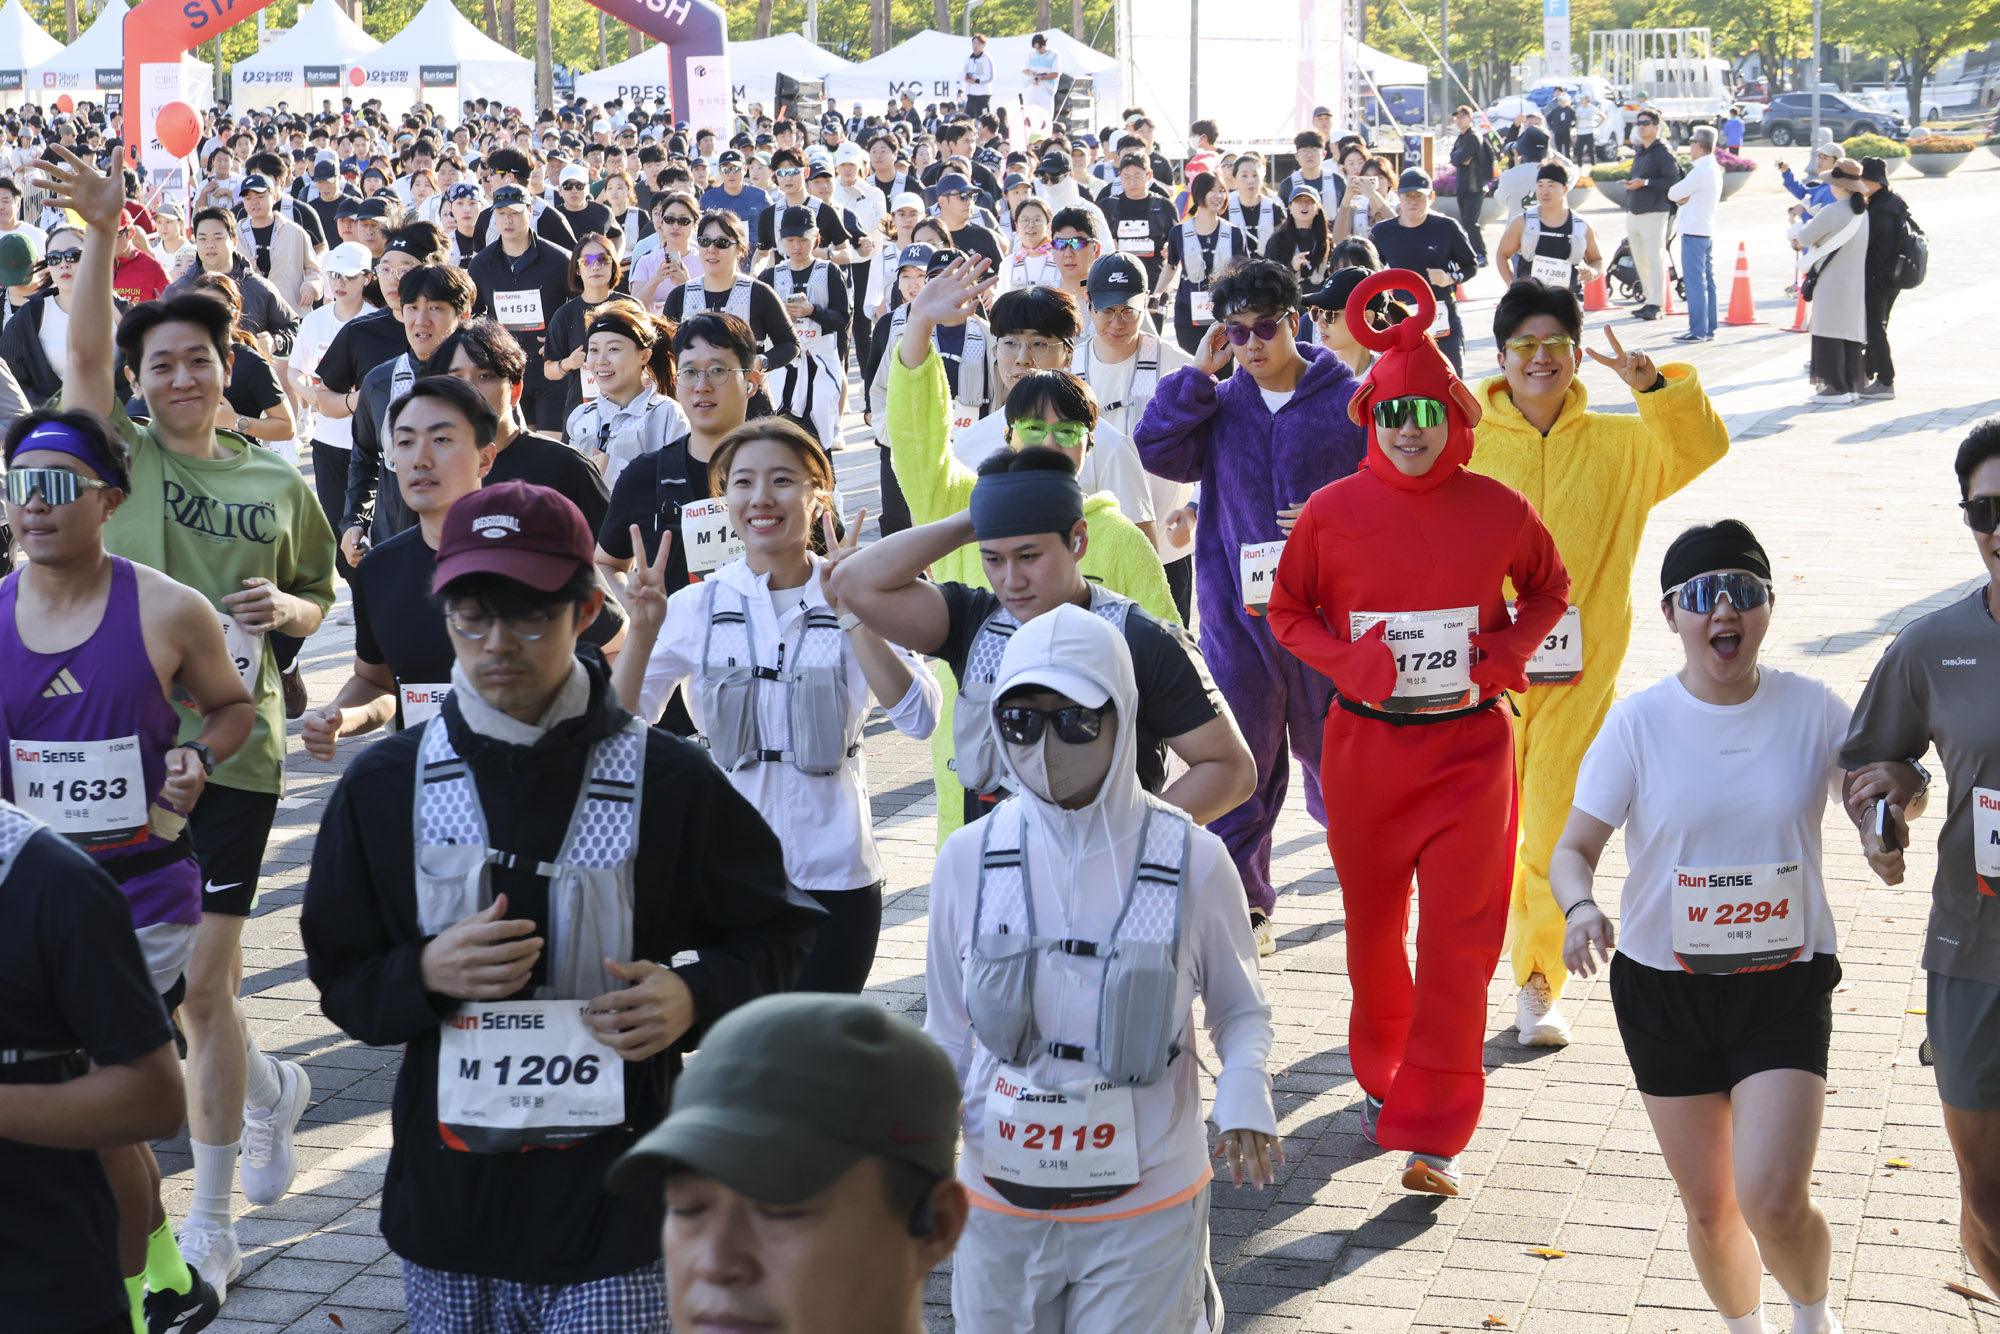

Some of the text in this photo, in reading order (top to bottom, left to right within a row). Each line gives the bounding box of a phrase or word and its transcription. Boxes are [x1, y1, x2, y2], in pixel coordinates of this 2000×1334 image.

[307, 71, 320, 80] Run
[423, 71, 436, 80] Run
[889, 80, 923, 97] MC
[908, 246, 921, 258] NY
[510, 304, 536, 313] 1513
[954, 418, 971, 428] 48
[686, 507, 706, 518] Run
[697, 531, 711, 544] M
[1252, 571, 1264, 582] M
[1443, 621, 1463, 630] 10km
[1544, 634, 1569, 651] 31
[1396, 649, 1457, 672] 1728
[406, 691, 429, 703] Run
[16, 748, 40, 762] Run
[109, 743, 134, 752] 10km
[29, 777, 128, 802] M 1633
[1678, 873, 1706, 888] Run
[1776, 865, 1798, 875] 10km
[1688, 898, 1789, 925] W 2294
[459, 1055, 600, 1086] M 1206
[995, 1077, 1019, 1099] Run
[999, 1120, 1116, 1151] W 2119
[1038, 1160, 1068, 1171] 오지현
